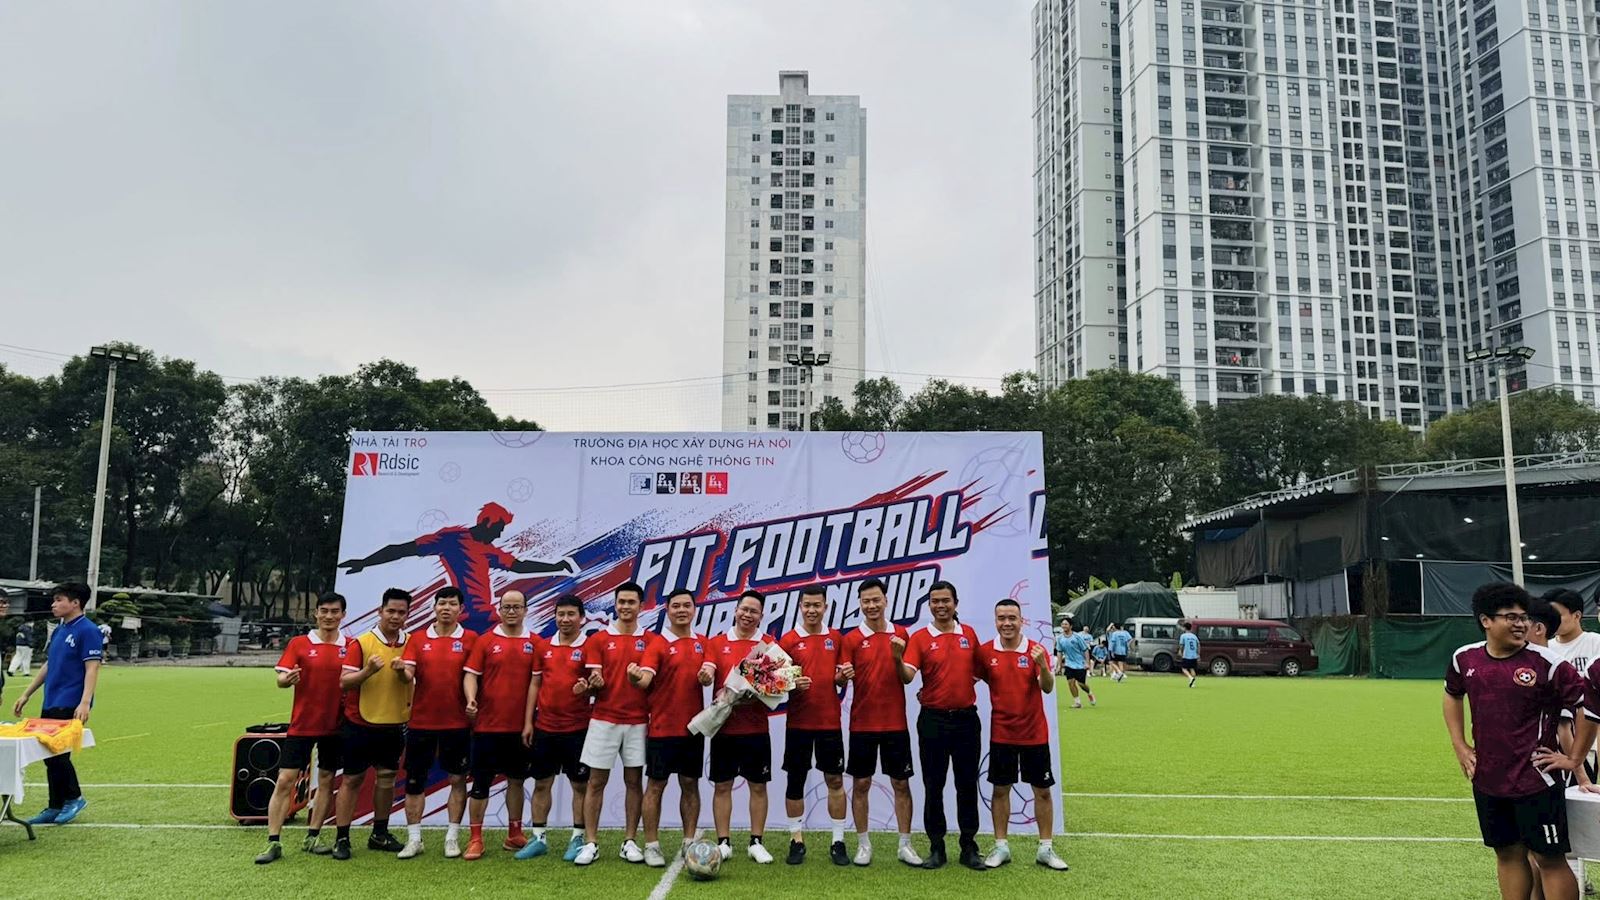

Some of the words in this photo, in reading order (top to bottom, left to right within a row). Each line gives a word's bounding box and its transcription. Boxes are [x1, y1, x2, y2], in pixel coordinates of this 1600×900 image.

[351, 436, 377, 447] NHÀ
[382, 436, 399, 447] TÀI
[652, 438, 679, 450] HỌC
[682, 437, 705, 448] XÂY
[709, 438, 744, 449] DỰNG
[748, 437, 765, 448] HÀ
[769, 437, 791, 449] NỘI
[379, 453, 420, 469] Rdsic
[590, 456, 625, 466] KHOA
[628, 454, 665, 466] CÔNG
[708, 454, 751, 466] THÔNG
[756, 456, 774, 466] TIN
[635, 534, 717, 597] FIT
[725, 493, 970, 587] FOOTBALL
[1542, 824, 1559, 845] 11
